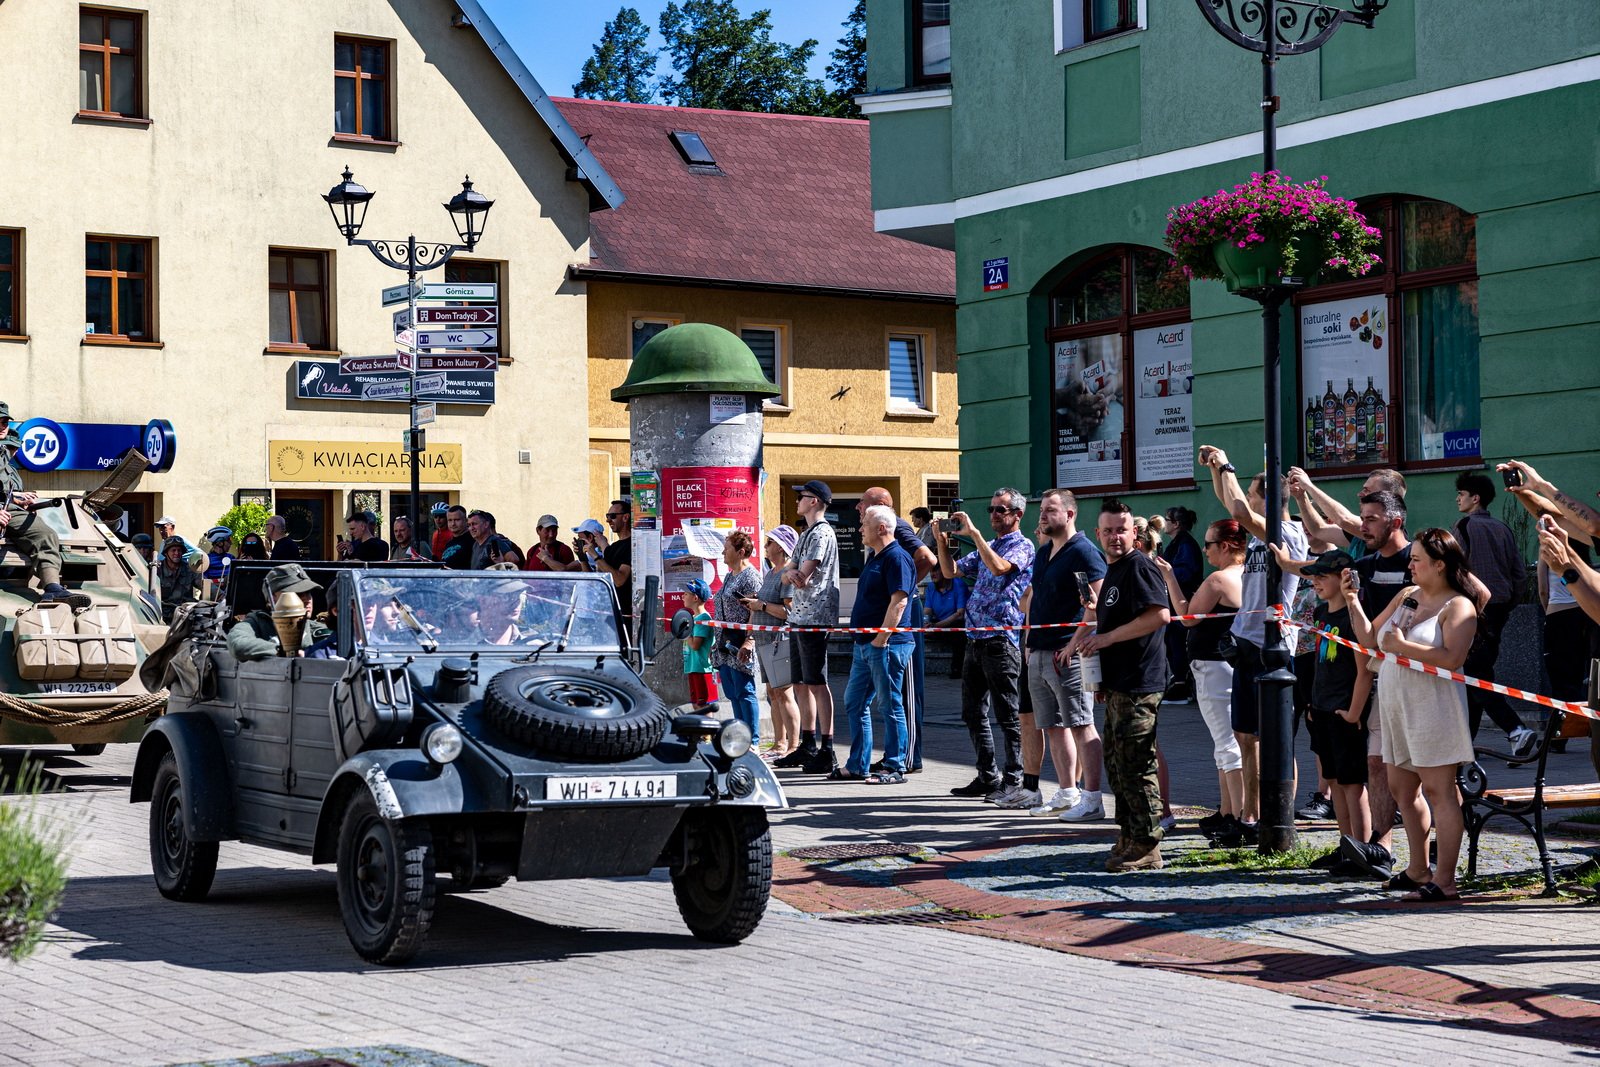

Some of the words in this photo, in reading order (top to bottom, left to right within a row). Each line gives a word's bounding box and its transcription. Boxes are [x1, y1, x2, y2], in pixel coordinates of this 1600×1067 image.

[989, 268, 1003, 284] 2A
[445, 287, 474, 295] Górnicza
[435, 312, 451, 320] Dom
[452, 311, 477, 322] Tradycji
[1303, 312, 1341, 325] naturalne
[1323, 322, 1341, 334] soki
[448, 335, 463, 343] WC
[1157, 331, 1184, 344] Acard
[1058, 345, 1078, 357] Acard
[352, 360, 372, 371] Kaplica
[438, 359, 453, 367] Dom
[455, 358, 479, 369] Kultury
[1171, 362, 1187, 372] Acard
[1083, 363, 1100, 380] Acard
[1144, 363, 1165, 377] Acard
[323, 382, 351, 393] Vitalis
[1164, 407, 1181, 416] TERAZ
[1166, 416, 1186, 425] NOWYM
[25, 433, 57, 458] PZU
[147, 435, 161, 457] PZU
[1445, 437, 1480, 451] VICHY
[313, 452, 447, 468] KWIACIARNIA
[676, 484, 702, 492] BLACK
[677, 500, 702, 508] WHITE
[736, 526, 755, 535] KAZJI
[44, 684, 62, 693] WH
[68, 682, 112, 693] 222549
